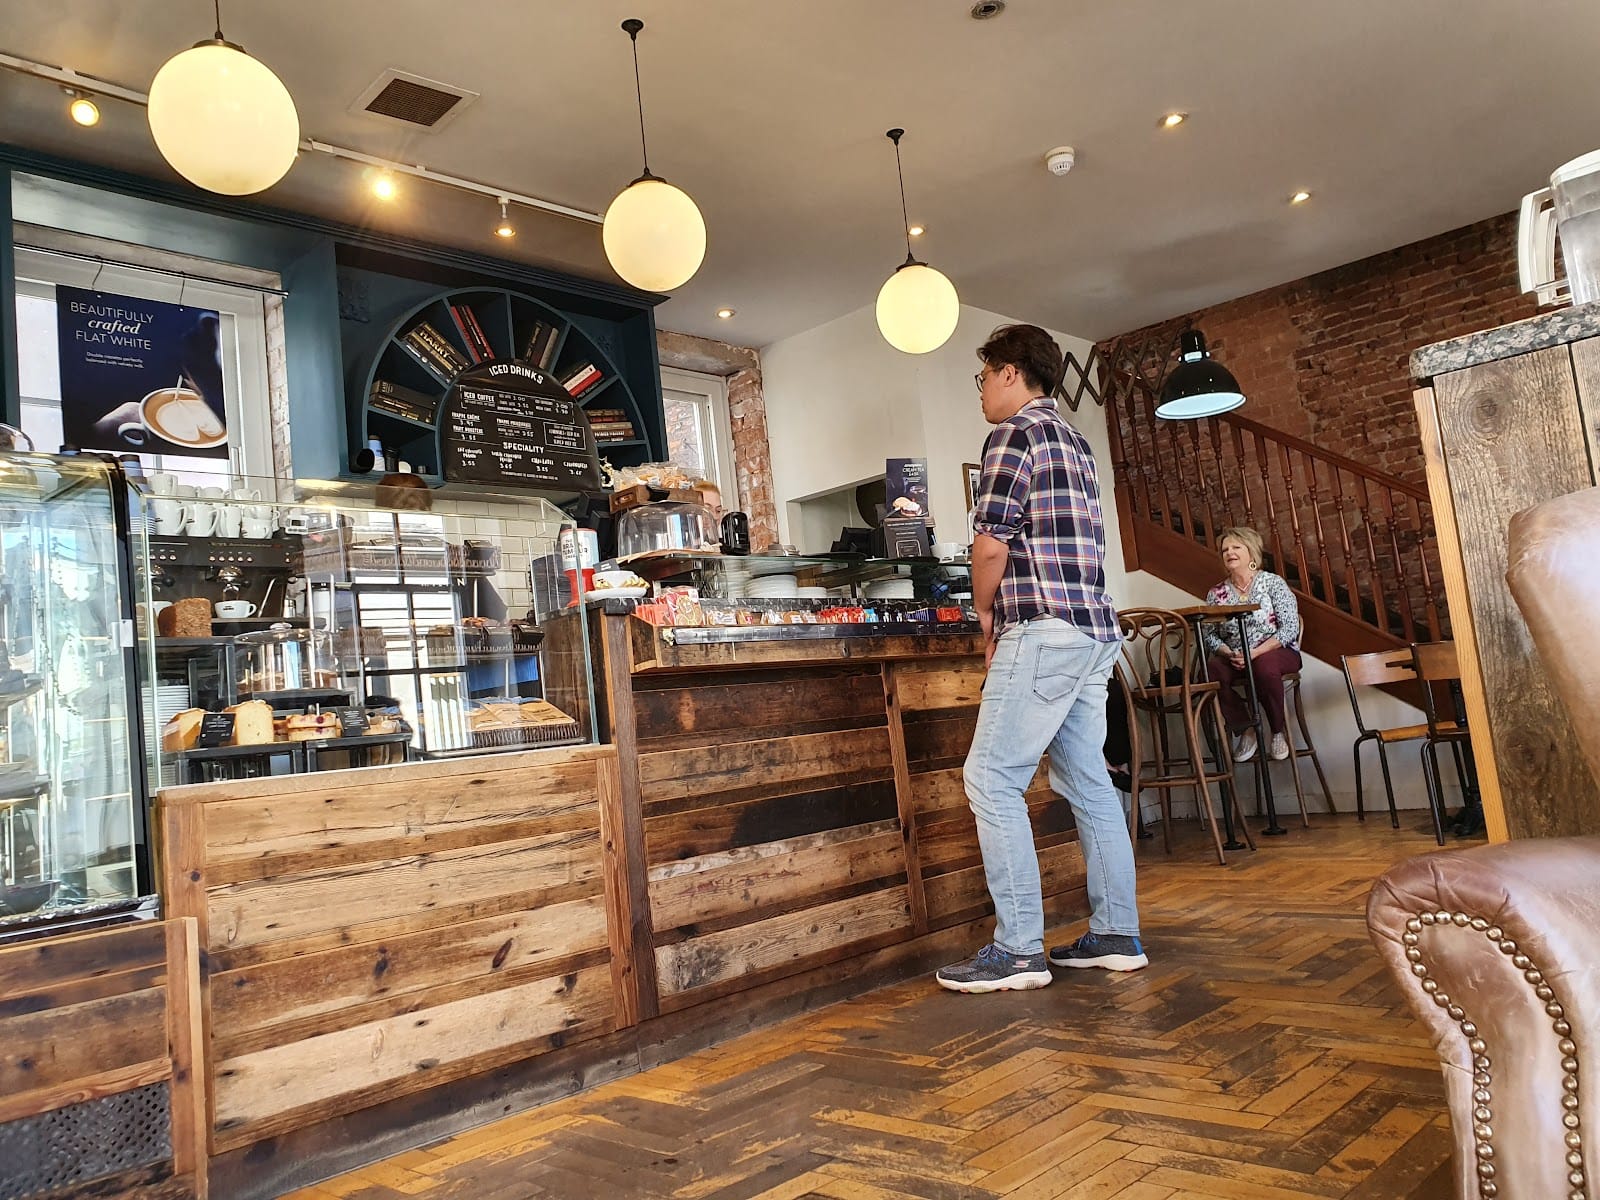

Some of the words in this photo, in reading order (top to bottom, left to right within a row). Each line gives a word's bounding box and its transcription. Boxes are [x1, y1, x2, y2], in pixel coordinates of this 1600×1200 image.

[70, 301, 154, 324] BEAUTIFULLY
[88, 319, 141, 335] crafted
[75, 330, 107, 344] FLAT
[110, 334, 152, 350] WHITE
[420, 330, 450, 358] HARRY
[489, 364, 509, 377] ICED
[510, 365, 544, 385] DRINKS
[463, 391, 476, 400] ICED
[476, 393, 495, 402] COFFEE
[502, 441, 545, 454] SPECIALITY
